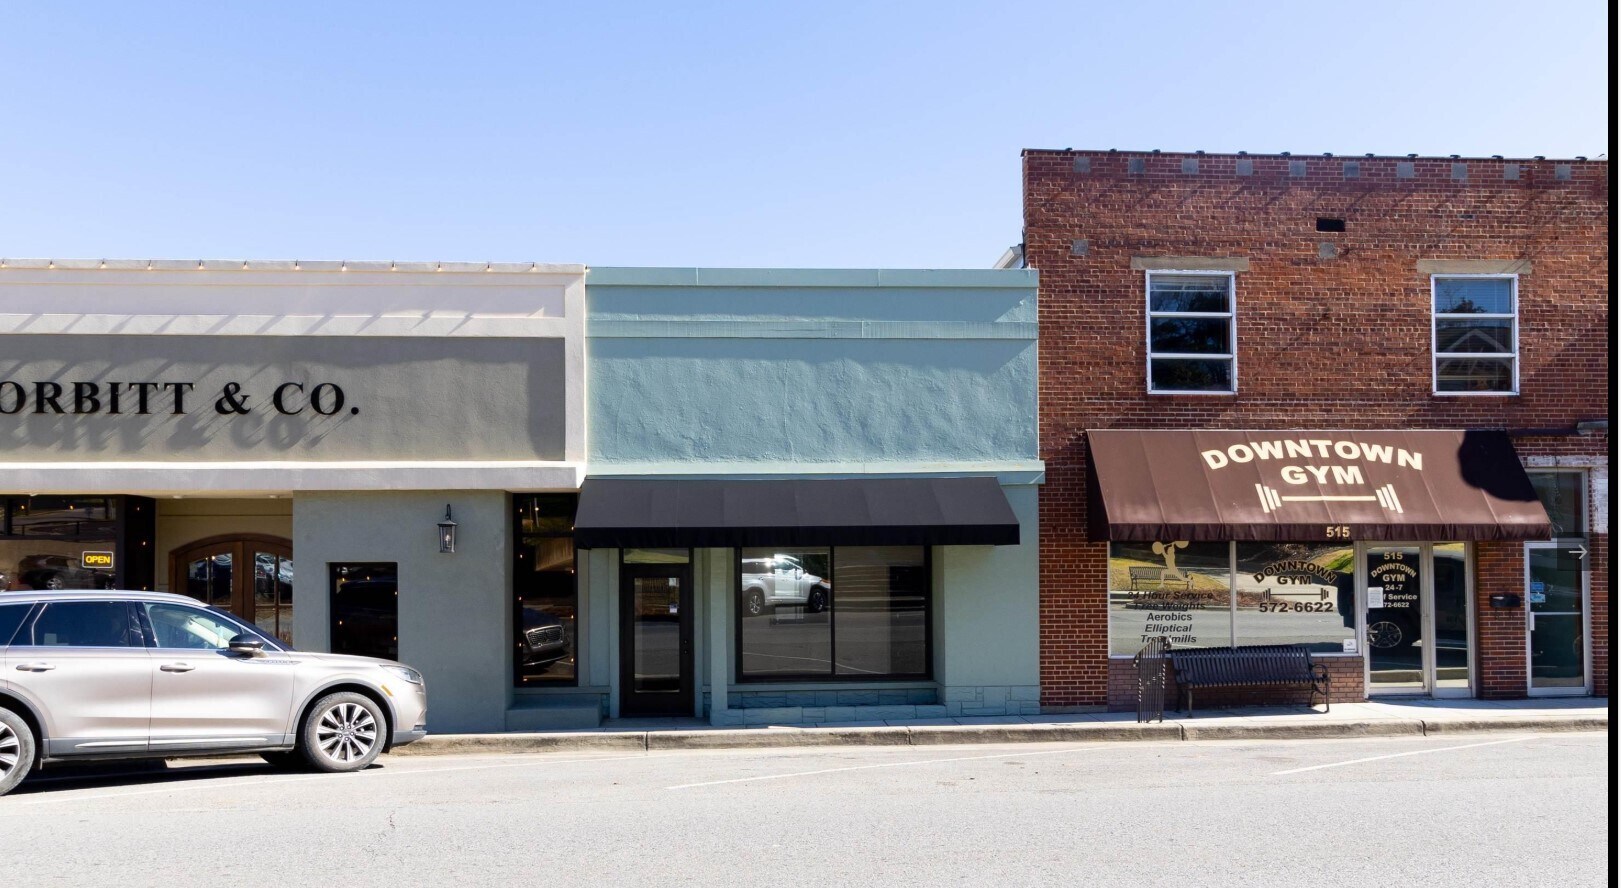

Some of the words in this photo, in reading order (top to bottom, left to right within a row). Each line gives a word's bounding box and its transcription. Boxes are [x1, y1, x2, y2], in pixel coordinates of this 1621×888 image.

[0, 381, 194, 415] ORBITT
[214, 381, 252, 416] &
[272, 381, 359, 416] CO.
[1201, 439, 1423, 471] DOWNTOWN
[1280, 465, 1365, 485] GYM
[1326, 526, 1351, 538] 515
[85, 555, 111, 564] OPEN
[1383, 551, 1404, 560] 515
[1253, 560, 1337, 584] DOWNTOWN
[1370, 562, 1417, 578] DOWNTOWN
[1277, 575, 1312, 585] GYM
[1382, 573, 1406, 582] GYM
[1127, 591, 1140, 600] 24
[1143, 591, 1171, 600] Hour
[1173, 591, 1214, 600] Service
[1162, 601, 1206, 612] Weights
[1259, 601, 1334, 613] 572-6622
[1146, 612, 1193, 621] Aerobics
[1144, 624, 1193, 634] Elliptical
